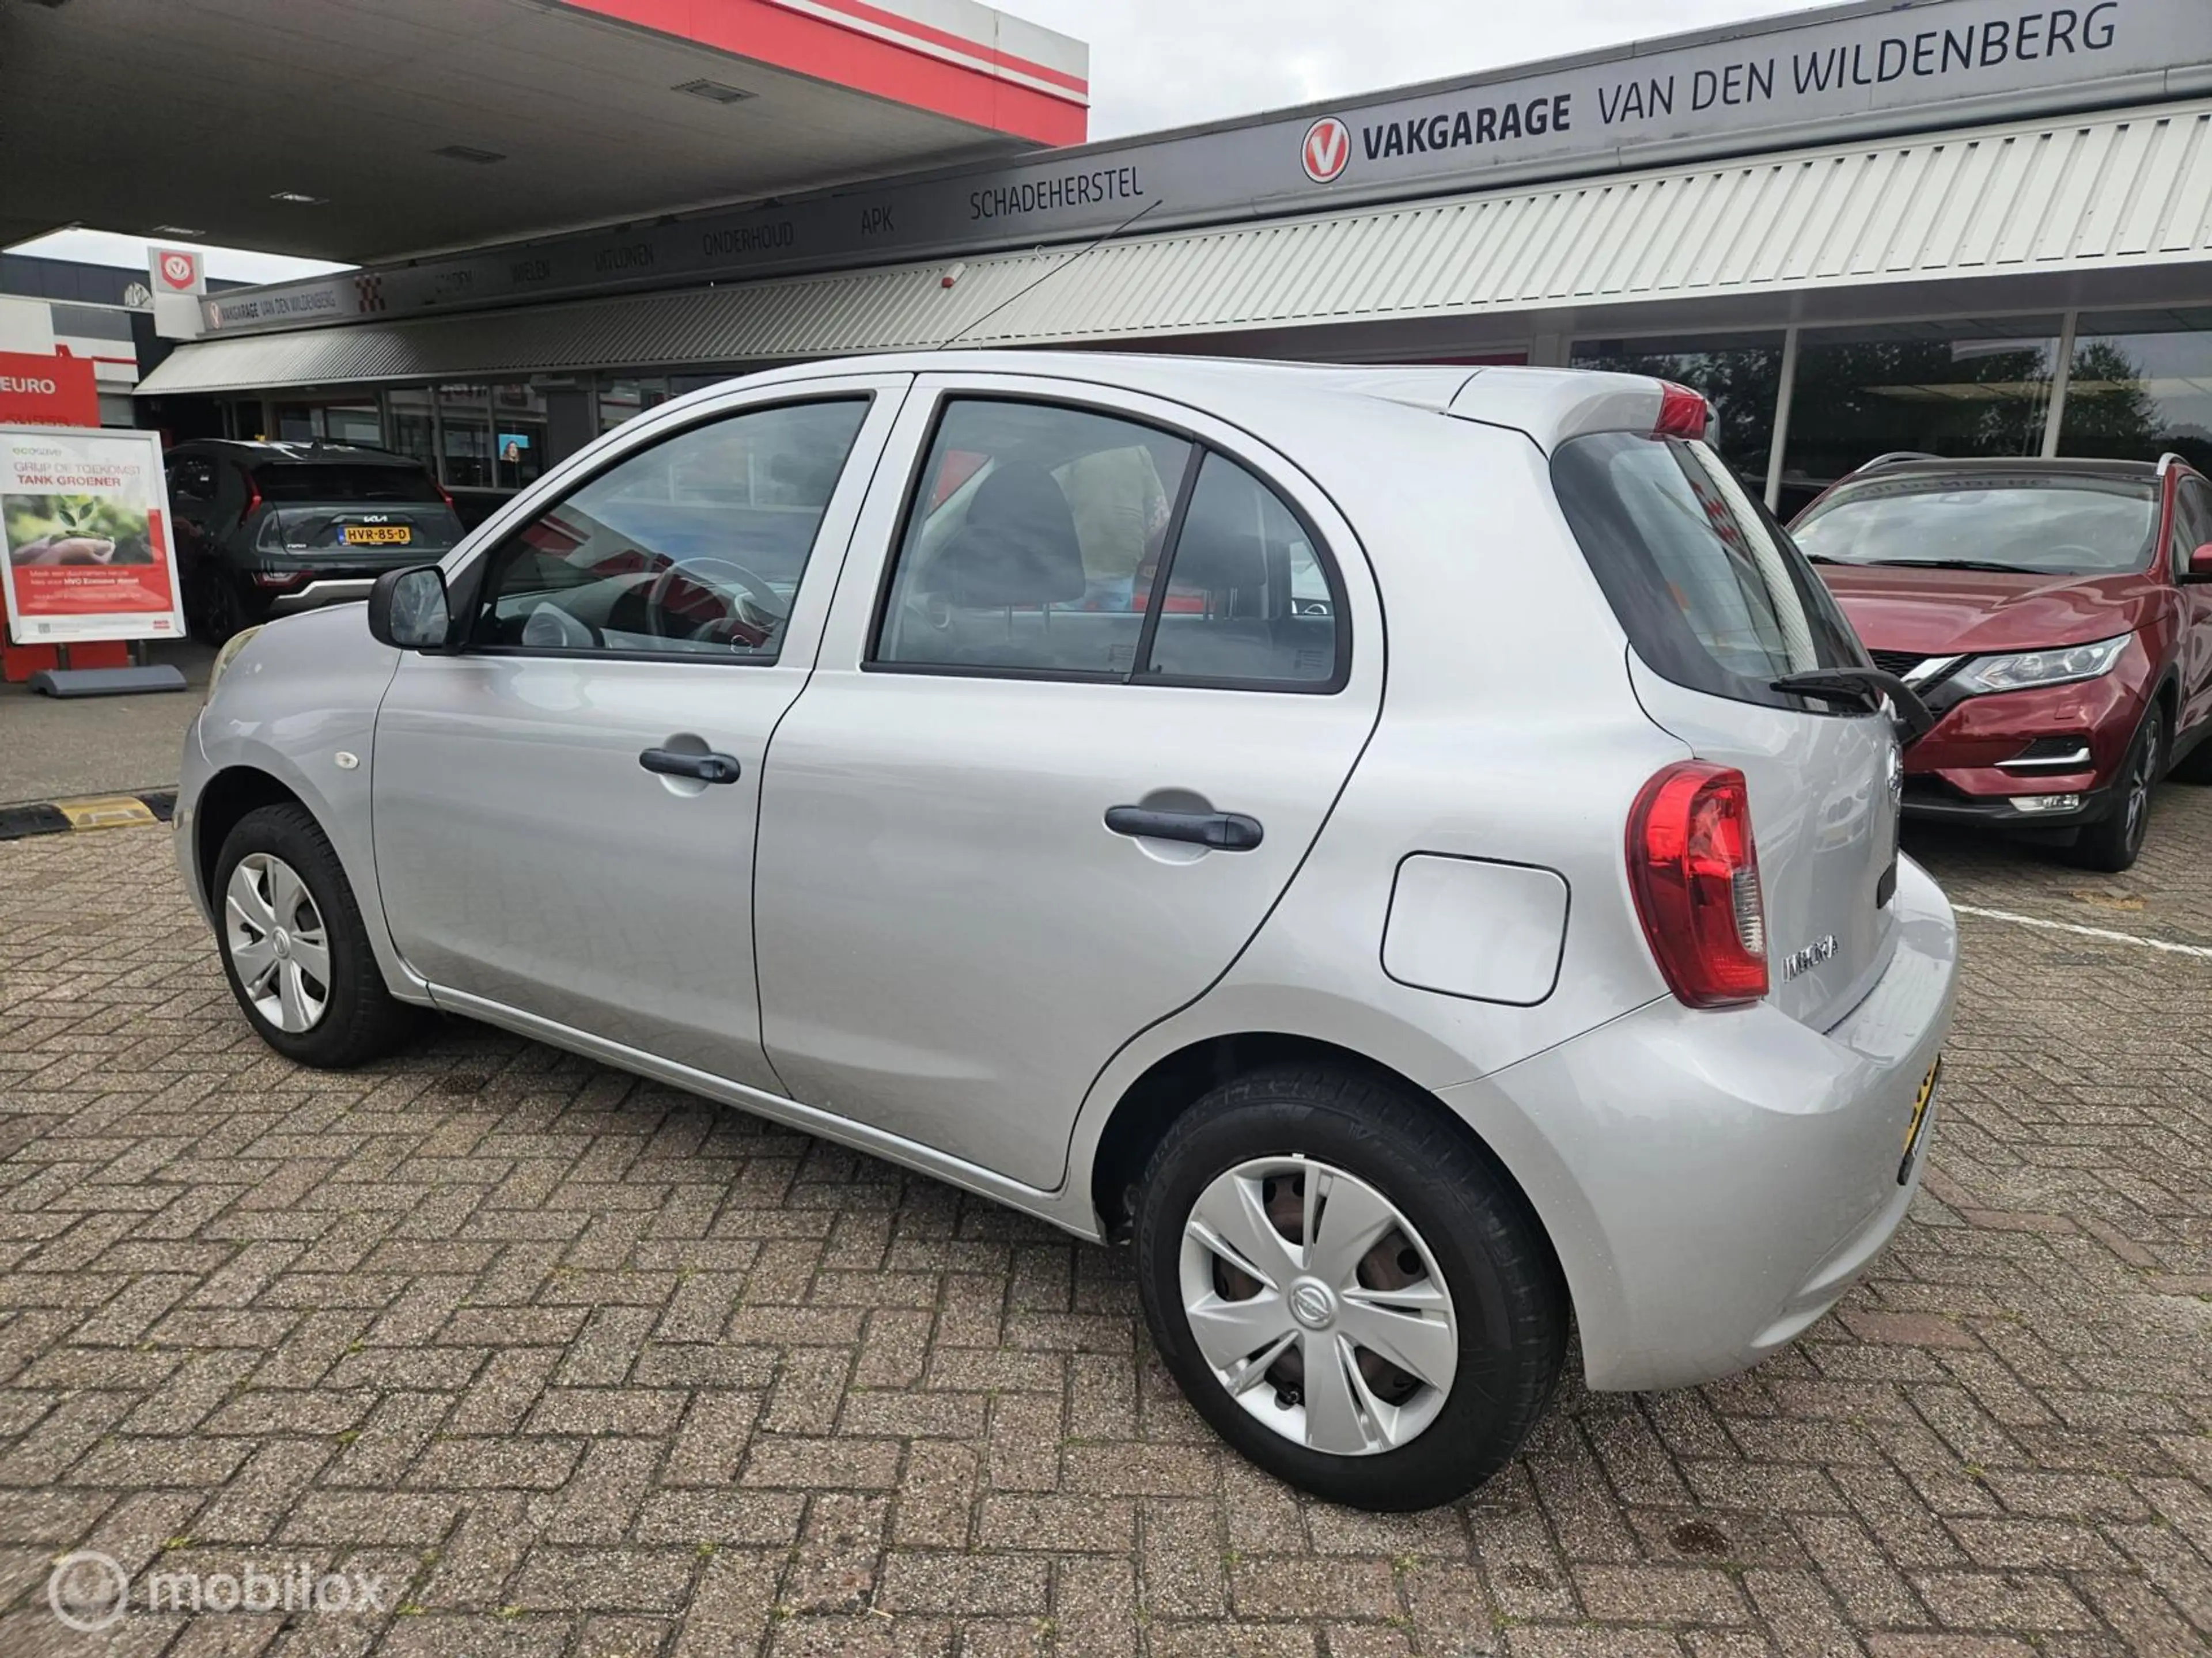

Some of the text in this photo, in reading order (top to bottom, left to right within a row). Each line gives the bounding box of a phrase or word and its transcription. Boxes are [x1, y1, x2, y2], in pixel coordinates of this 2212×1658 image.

[1363, 93, 1571, 160] VAKGARAGE
[1598, 76, 1674, 125] VAN
[1691, 58, 1775, 111] DEN
[1793, 2, 2118, 95] WILDENBERG
[970, 166, 1144, 220] SCHADEHERSTEL
[861, 204, 894, 234] APK
[702, 221, 794, 256] ONDERHOUD
[1, 376, 56, 394] EURO
[17, 475, 121, 487] TANK GROENER
[347, 529, 407, 541] HVR-85-D
